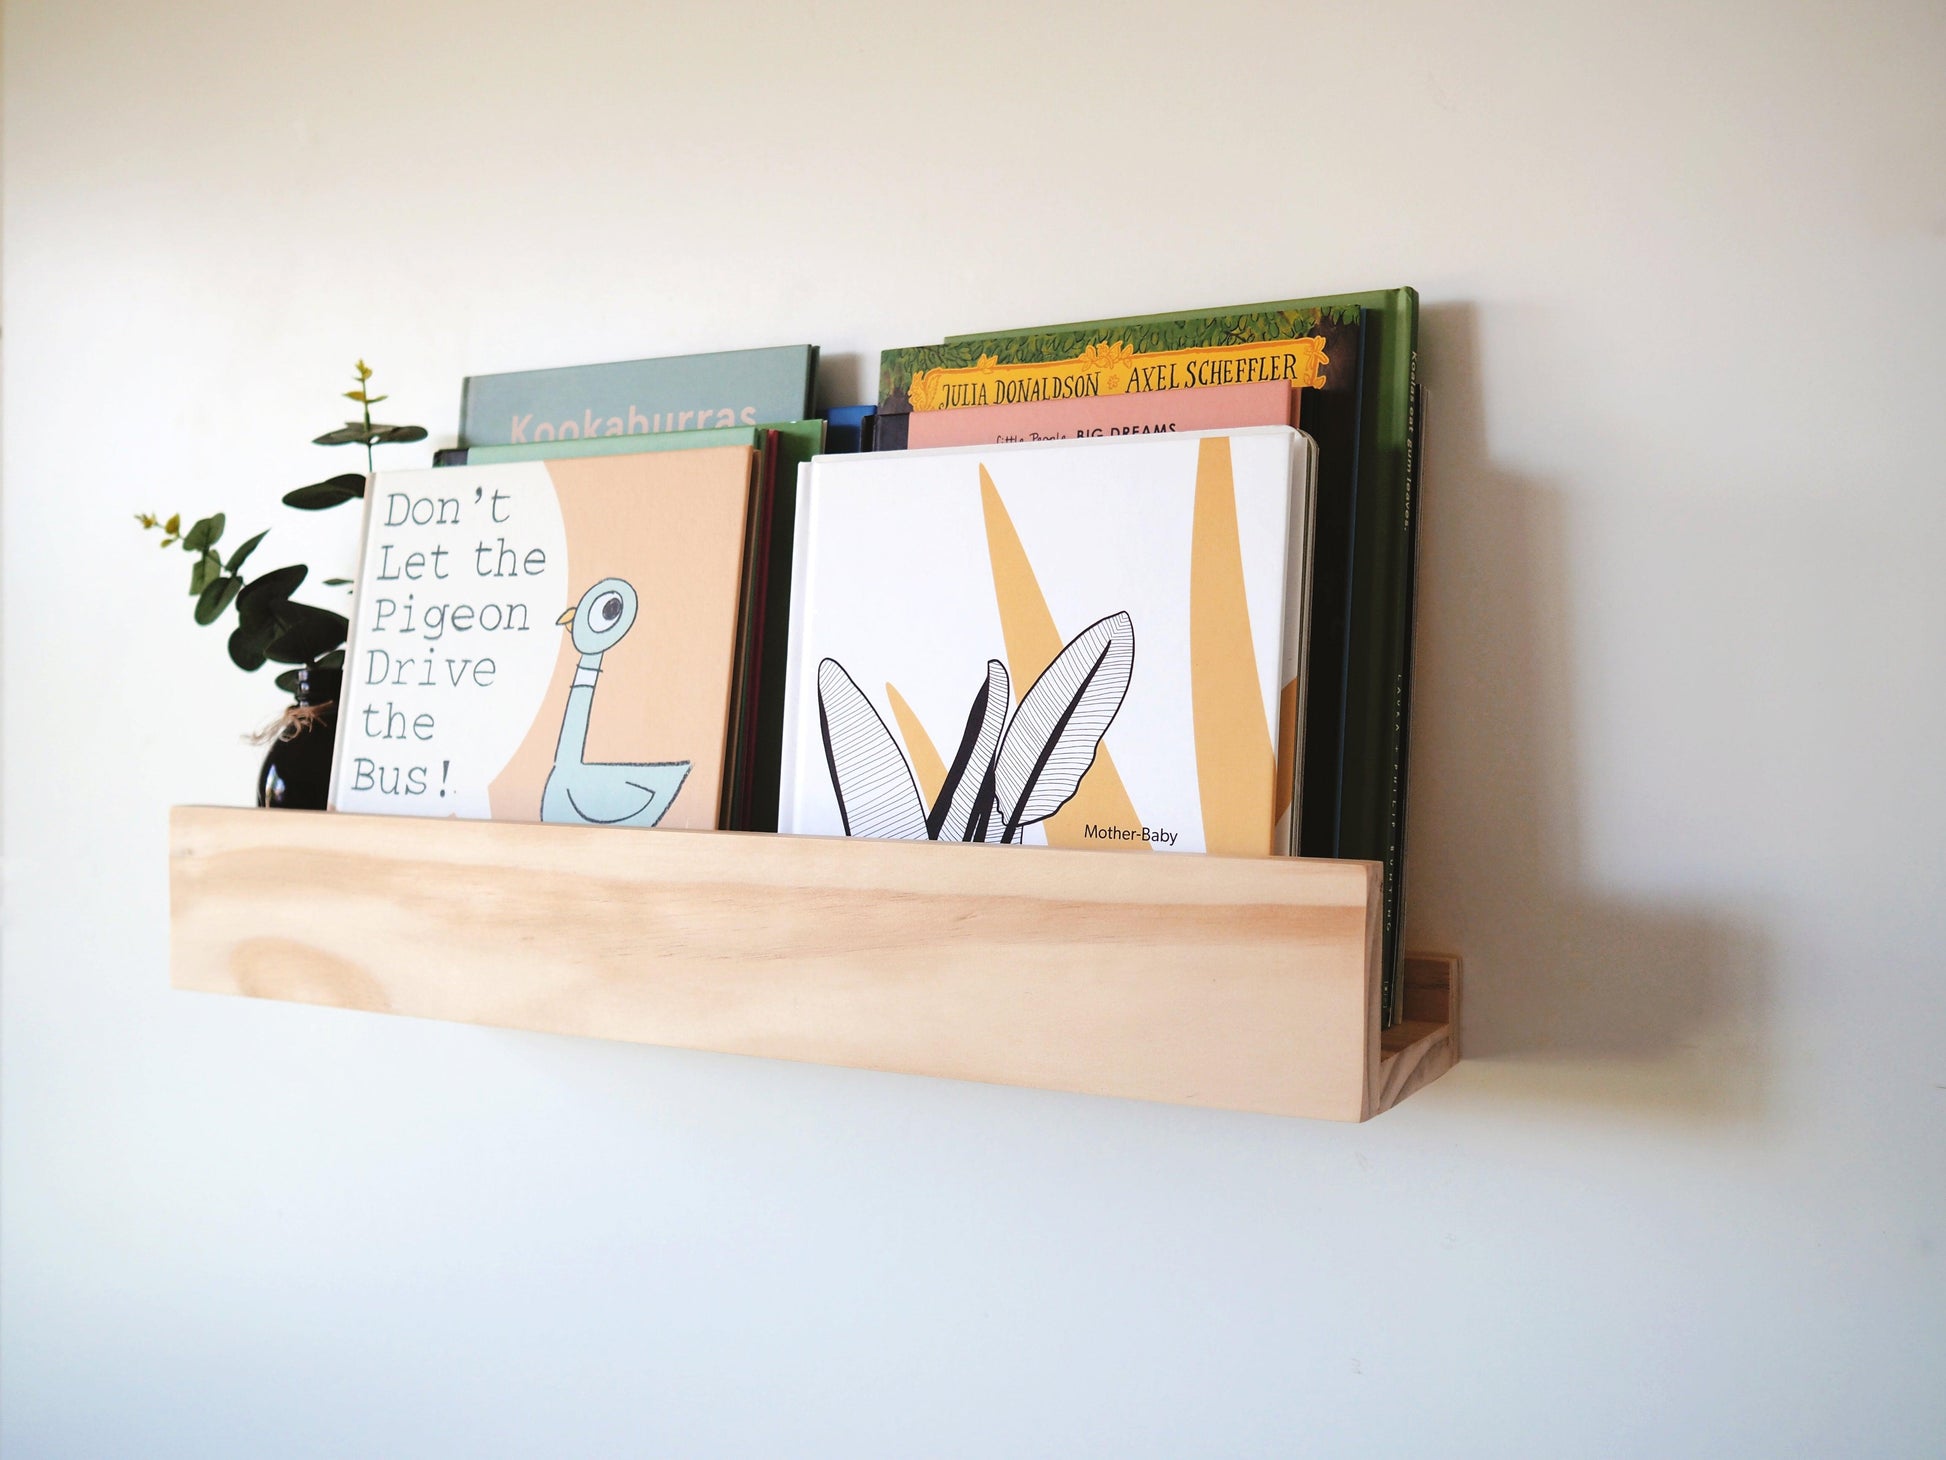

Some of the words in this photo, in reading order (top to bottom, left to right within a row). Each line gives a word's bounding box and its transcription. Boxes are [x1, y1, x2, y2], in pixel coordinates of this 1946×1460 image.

[938, 382, 989, 410] JULIA
[993, 372, 1101, 405] DONALDSON
[1125, 363, 1180, 393] AXEL
[1184, 353, 1298, 388] SCHEFFLER
[1409, 350, 1418, 402] Koalas
[510, 404, 757, 445] Kookaburras
[383, 486, 512, 528] Don't
[376, 543, 450, 581] Let
[474, 537, 547, 578] the
[370, 593, 531, 640] Pigeon
[364, 647, 497, 687] Drive
[361, 702, 436, 741] the
[350, 757, 451, 798] Bus!
[1083, 823, 1179, 847] Mother-Baby
